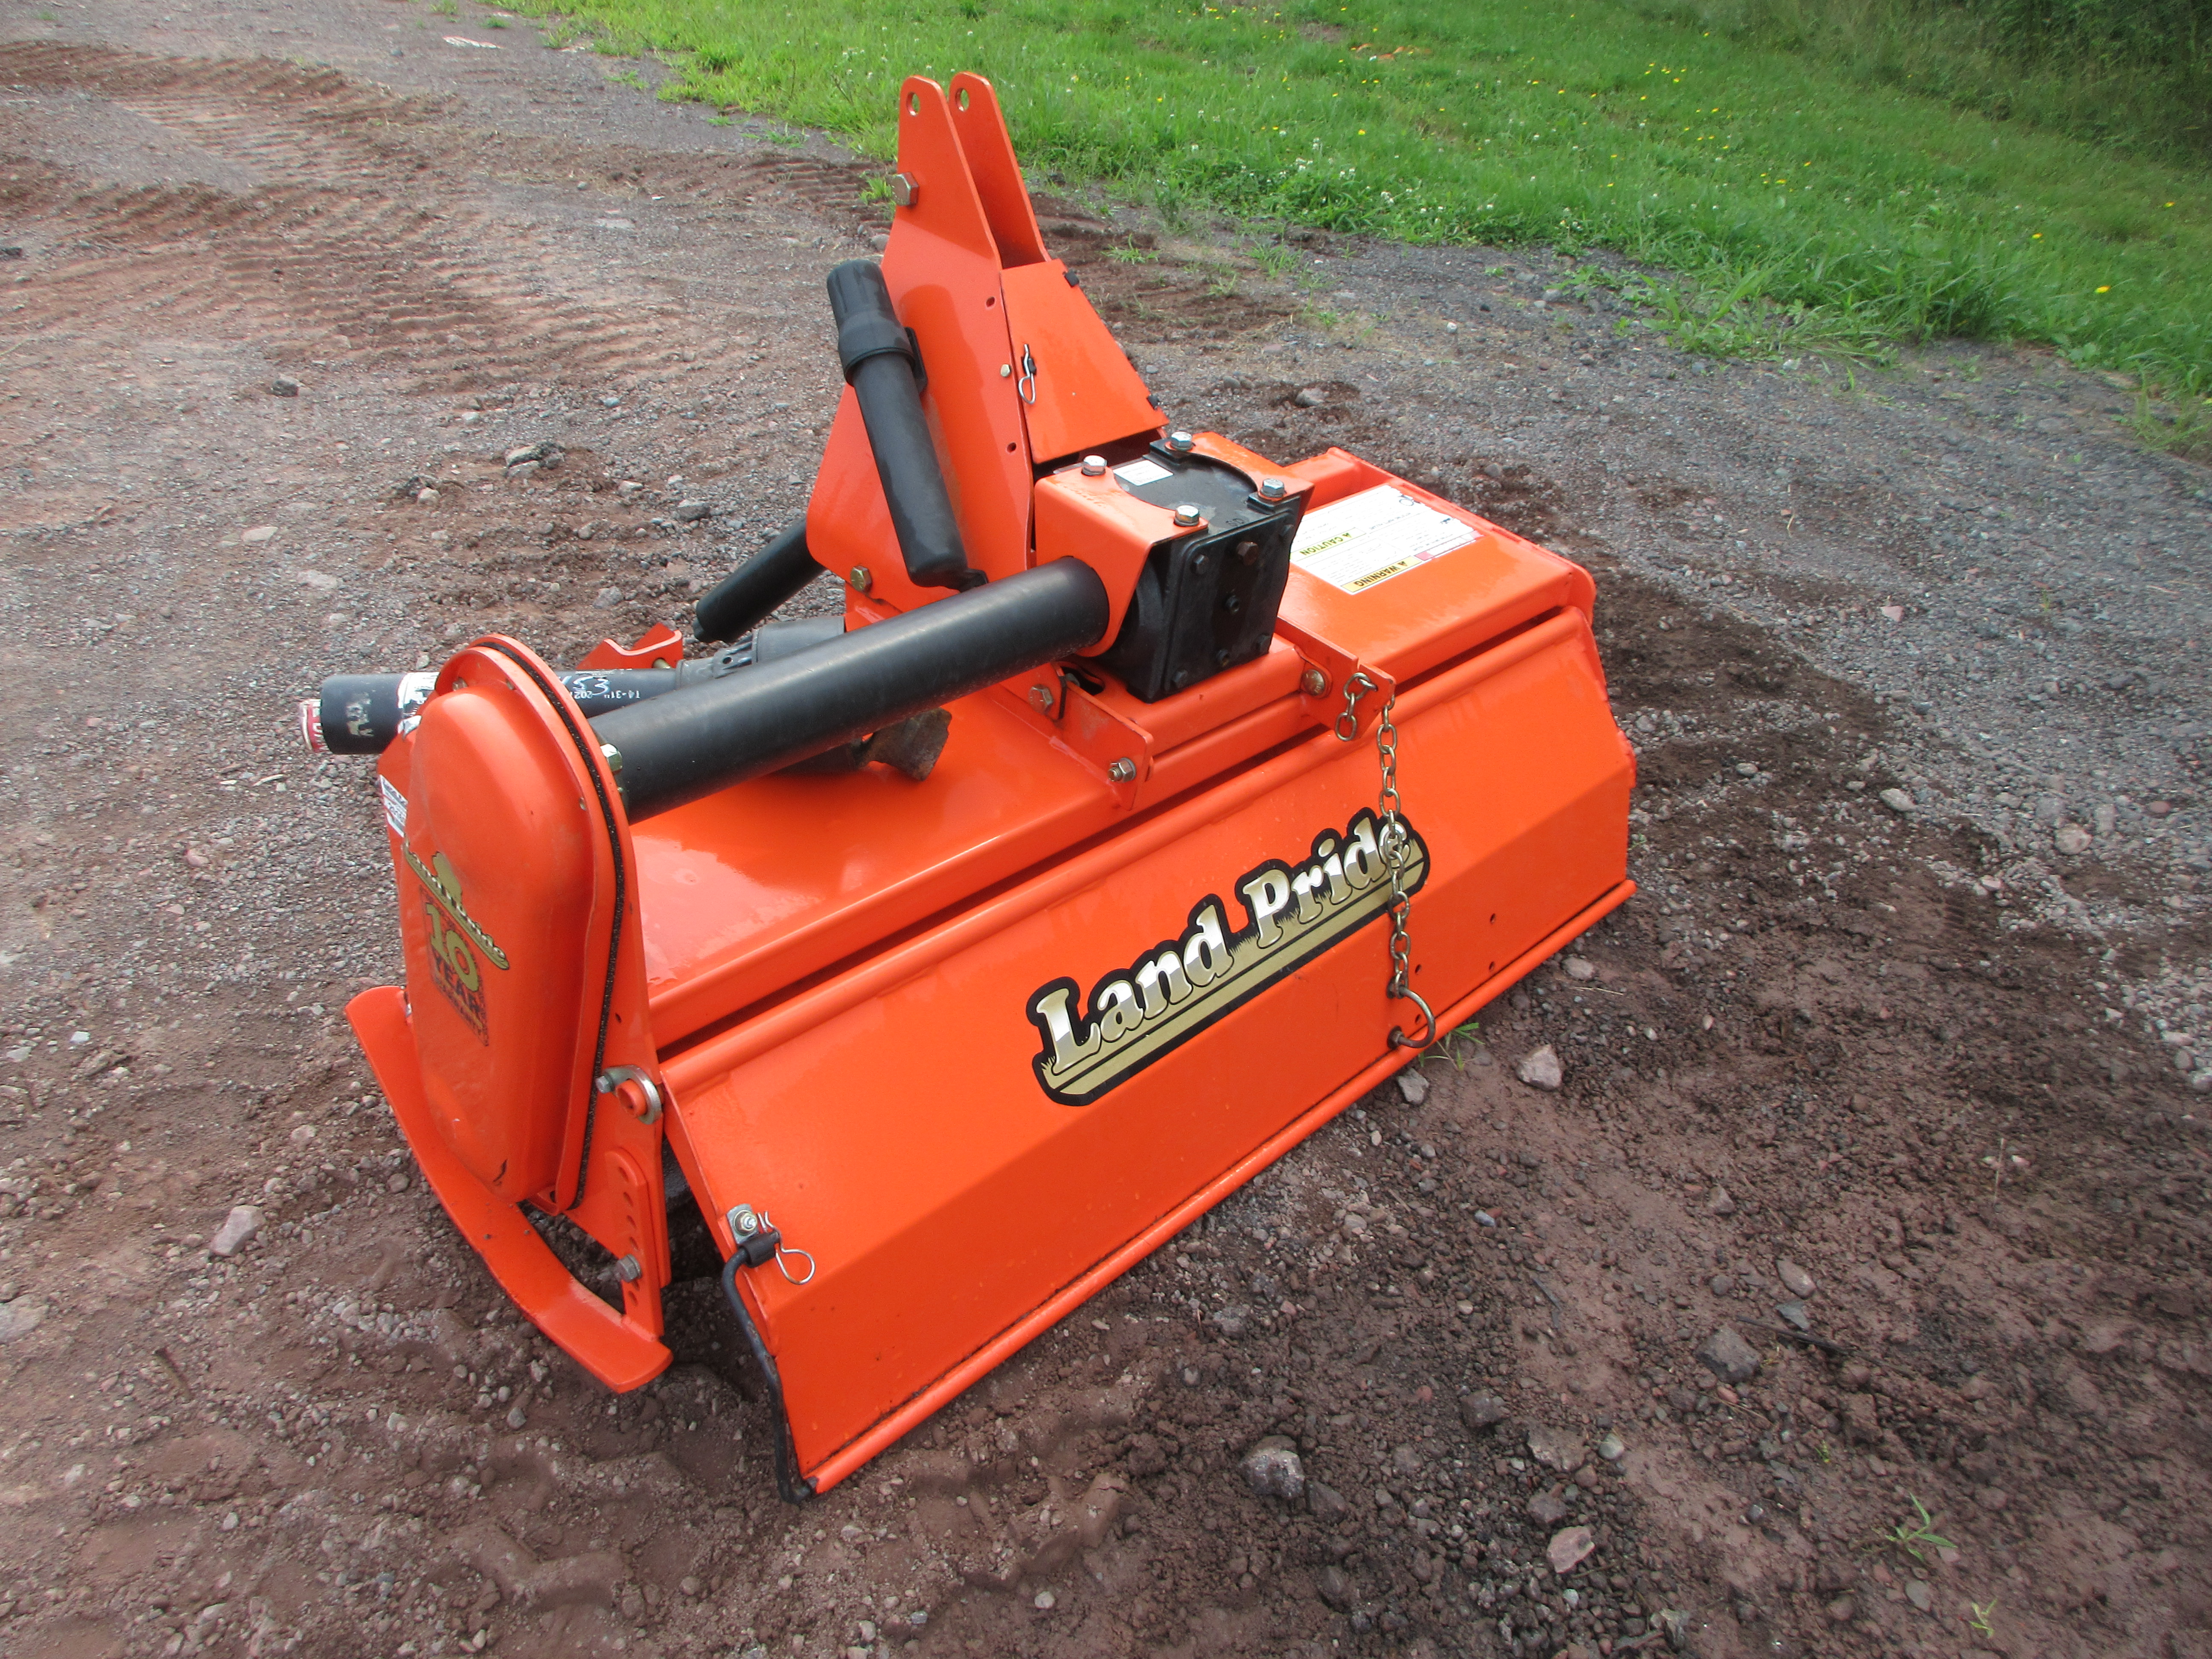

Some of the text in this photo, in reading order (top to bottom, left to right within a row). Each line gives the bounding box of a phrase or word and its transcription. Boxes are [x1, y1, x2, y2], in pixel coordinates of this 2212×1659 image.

[1300, 536, 1343, 556] CAUTION
[1354, 561, 1402, 587] WARNING
[426, 902, 479, 992] 10
[1034, 904, 1234, 1075] Land
